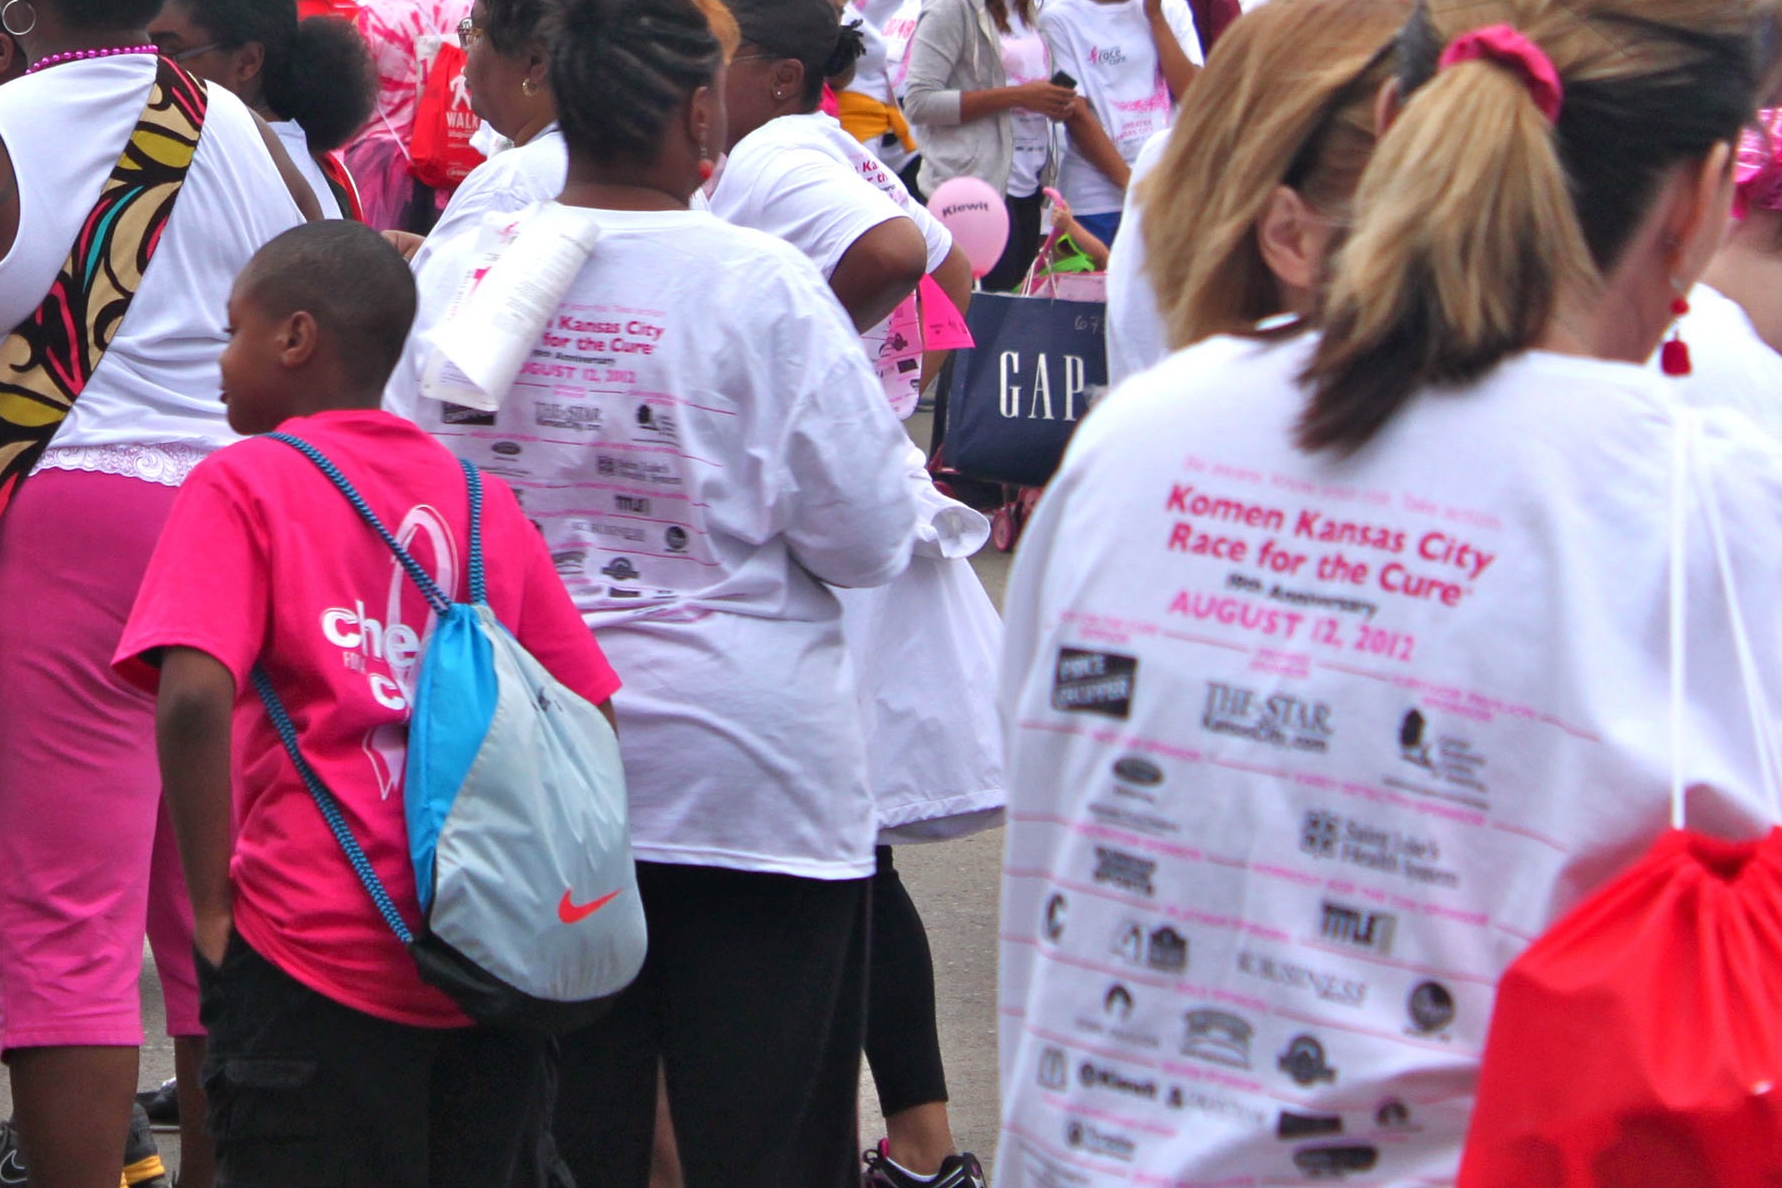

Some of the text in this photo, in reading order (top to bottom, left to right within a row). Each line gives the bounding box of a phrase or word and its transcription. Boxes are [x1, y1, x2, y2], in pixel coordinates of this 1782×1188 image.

[941, 200, 991, 219] Kiewit
[542, 331, 653, 356] for the Cure
[559, 315, 666, 342] Kansas City
[999, 350, 1086, 422] GAP
[1166, 484, 1497, 582] Komen Kansas City
[1167, 522, 1464, 608] Race for the Cure
[1169, 591, 1305, 641] AUGUST
[1311, 615, 1344, 652] 12,
[1353, 620, 1417, 663] 2012
